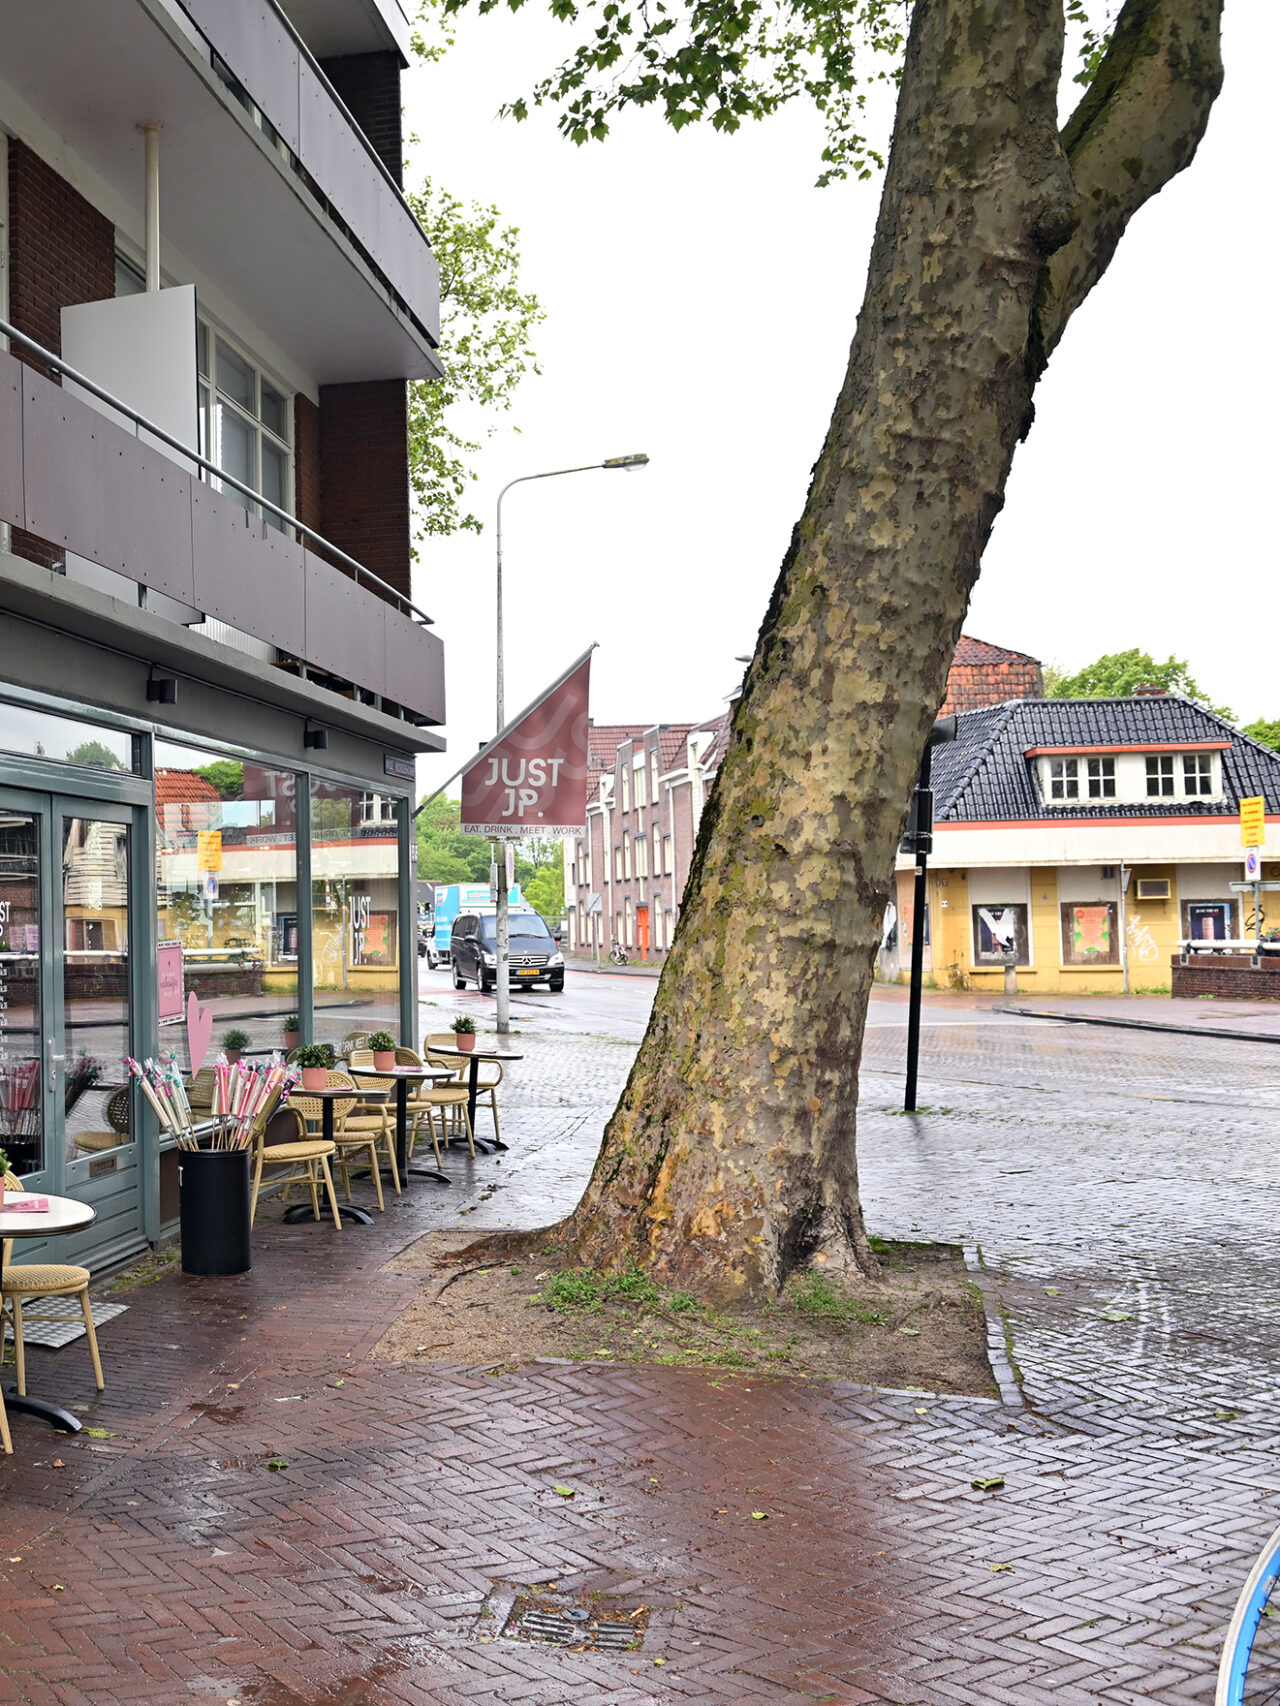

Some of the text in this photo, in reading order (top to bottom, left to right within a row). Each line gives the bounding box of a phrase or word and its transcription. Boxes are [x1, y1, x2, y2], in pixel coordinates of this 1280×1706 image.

[485, 758, 564, 787] JUST
[501, 788, 544, 817] JP.
[520, 826, 546, 834] MEET
[552, 827, 581, 835] WORK
[349, 896, 371, 929] JUST
